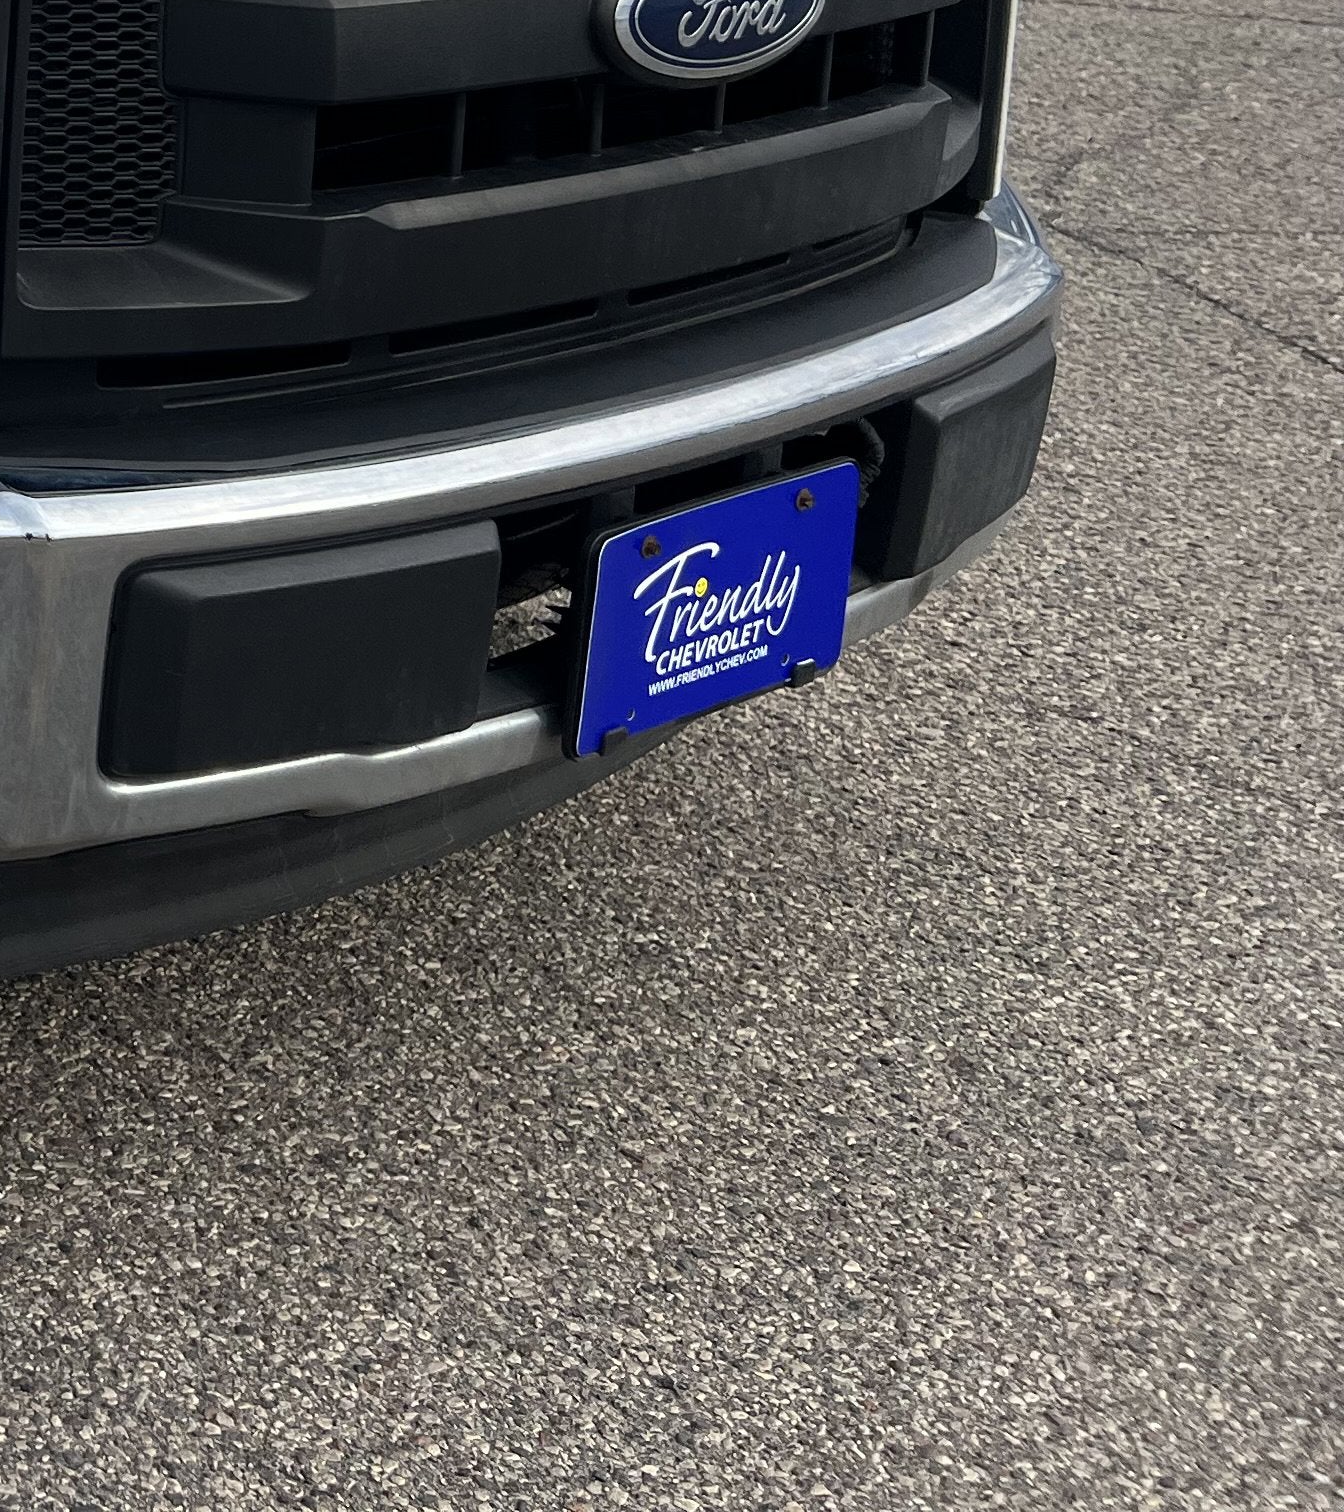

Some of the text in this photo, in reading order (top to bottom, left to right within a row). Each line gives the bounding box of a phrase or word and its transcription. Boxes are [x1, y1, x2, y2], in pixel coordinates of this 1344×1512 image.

[633, 541, 800, 663] Friendly
[647, 644, 769, 696] WWW.FRIENDLYCHEV.COM
[656, 619, 765, 675] CHEVROLET
